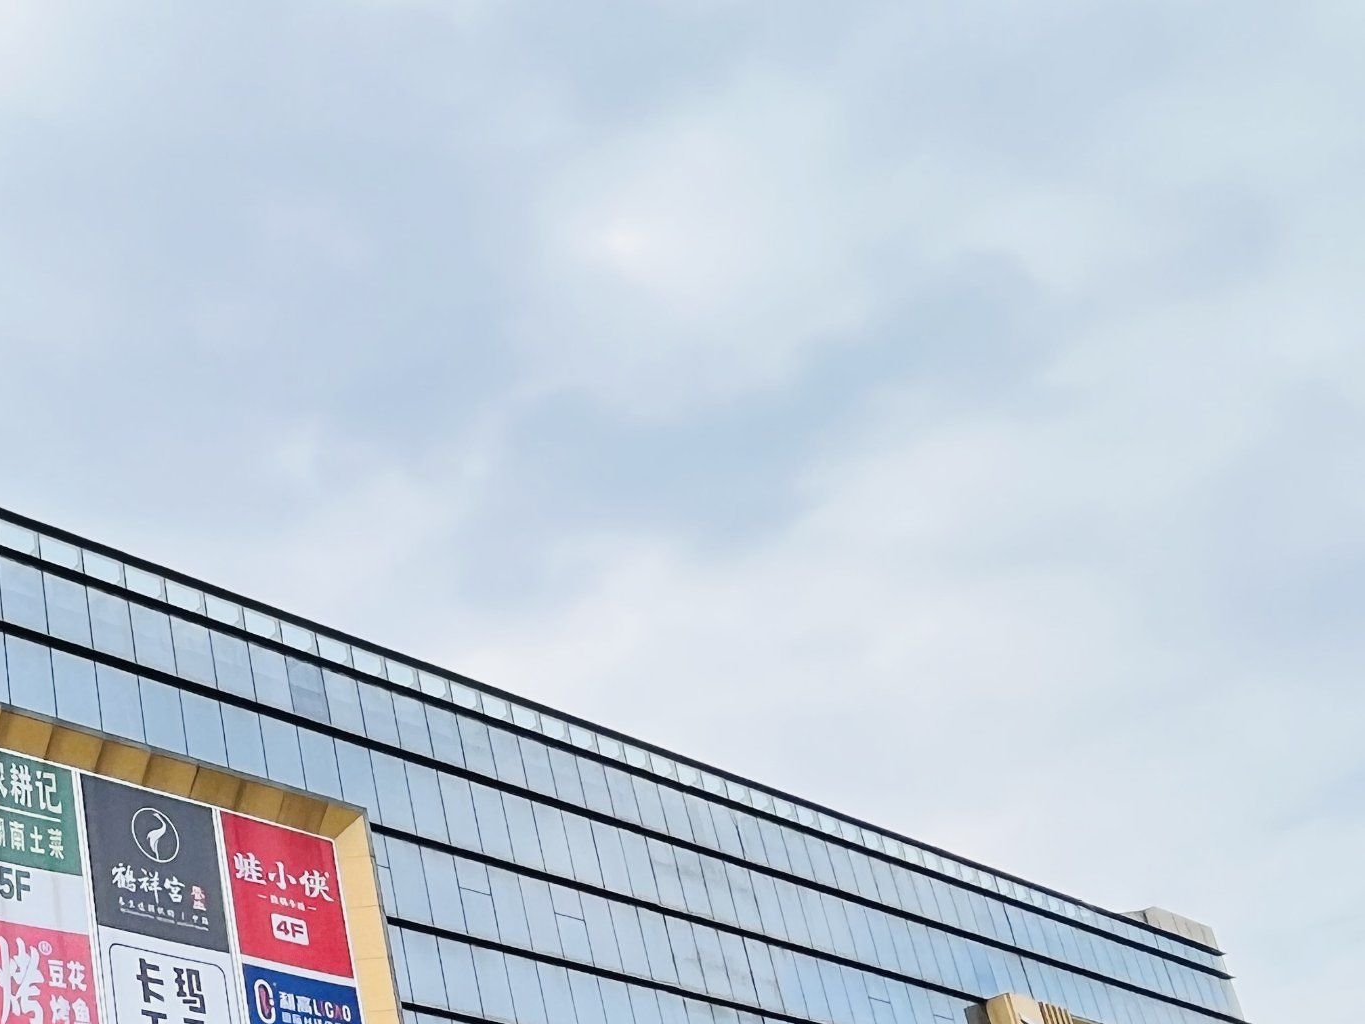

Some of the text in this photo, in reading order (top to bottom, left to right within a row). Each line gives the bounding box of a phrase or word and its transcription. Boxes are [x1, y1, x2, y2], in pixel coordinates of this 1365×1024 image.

[276, 920, 304, 938] 4F
[47, 959, 87, 991] 豆花
[136, 957, 207, 1014] 卡玛
